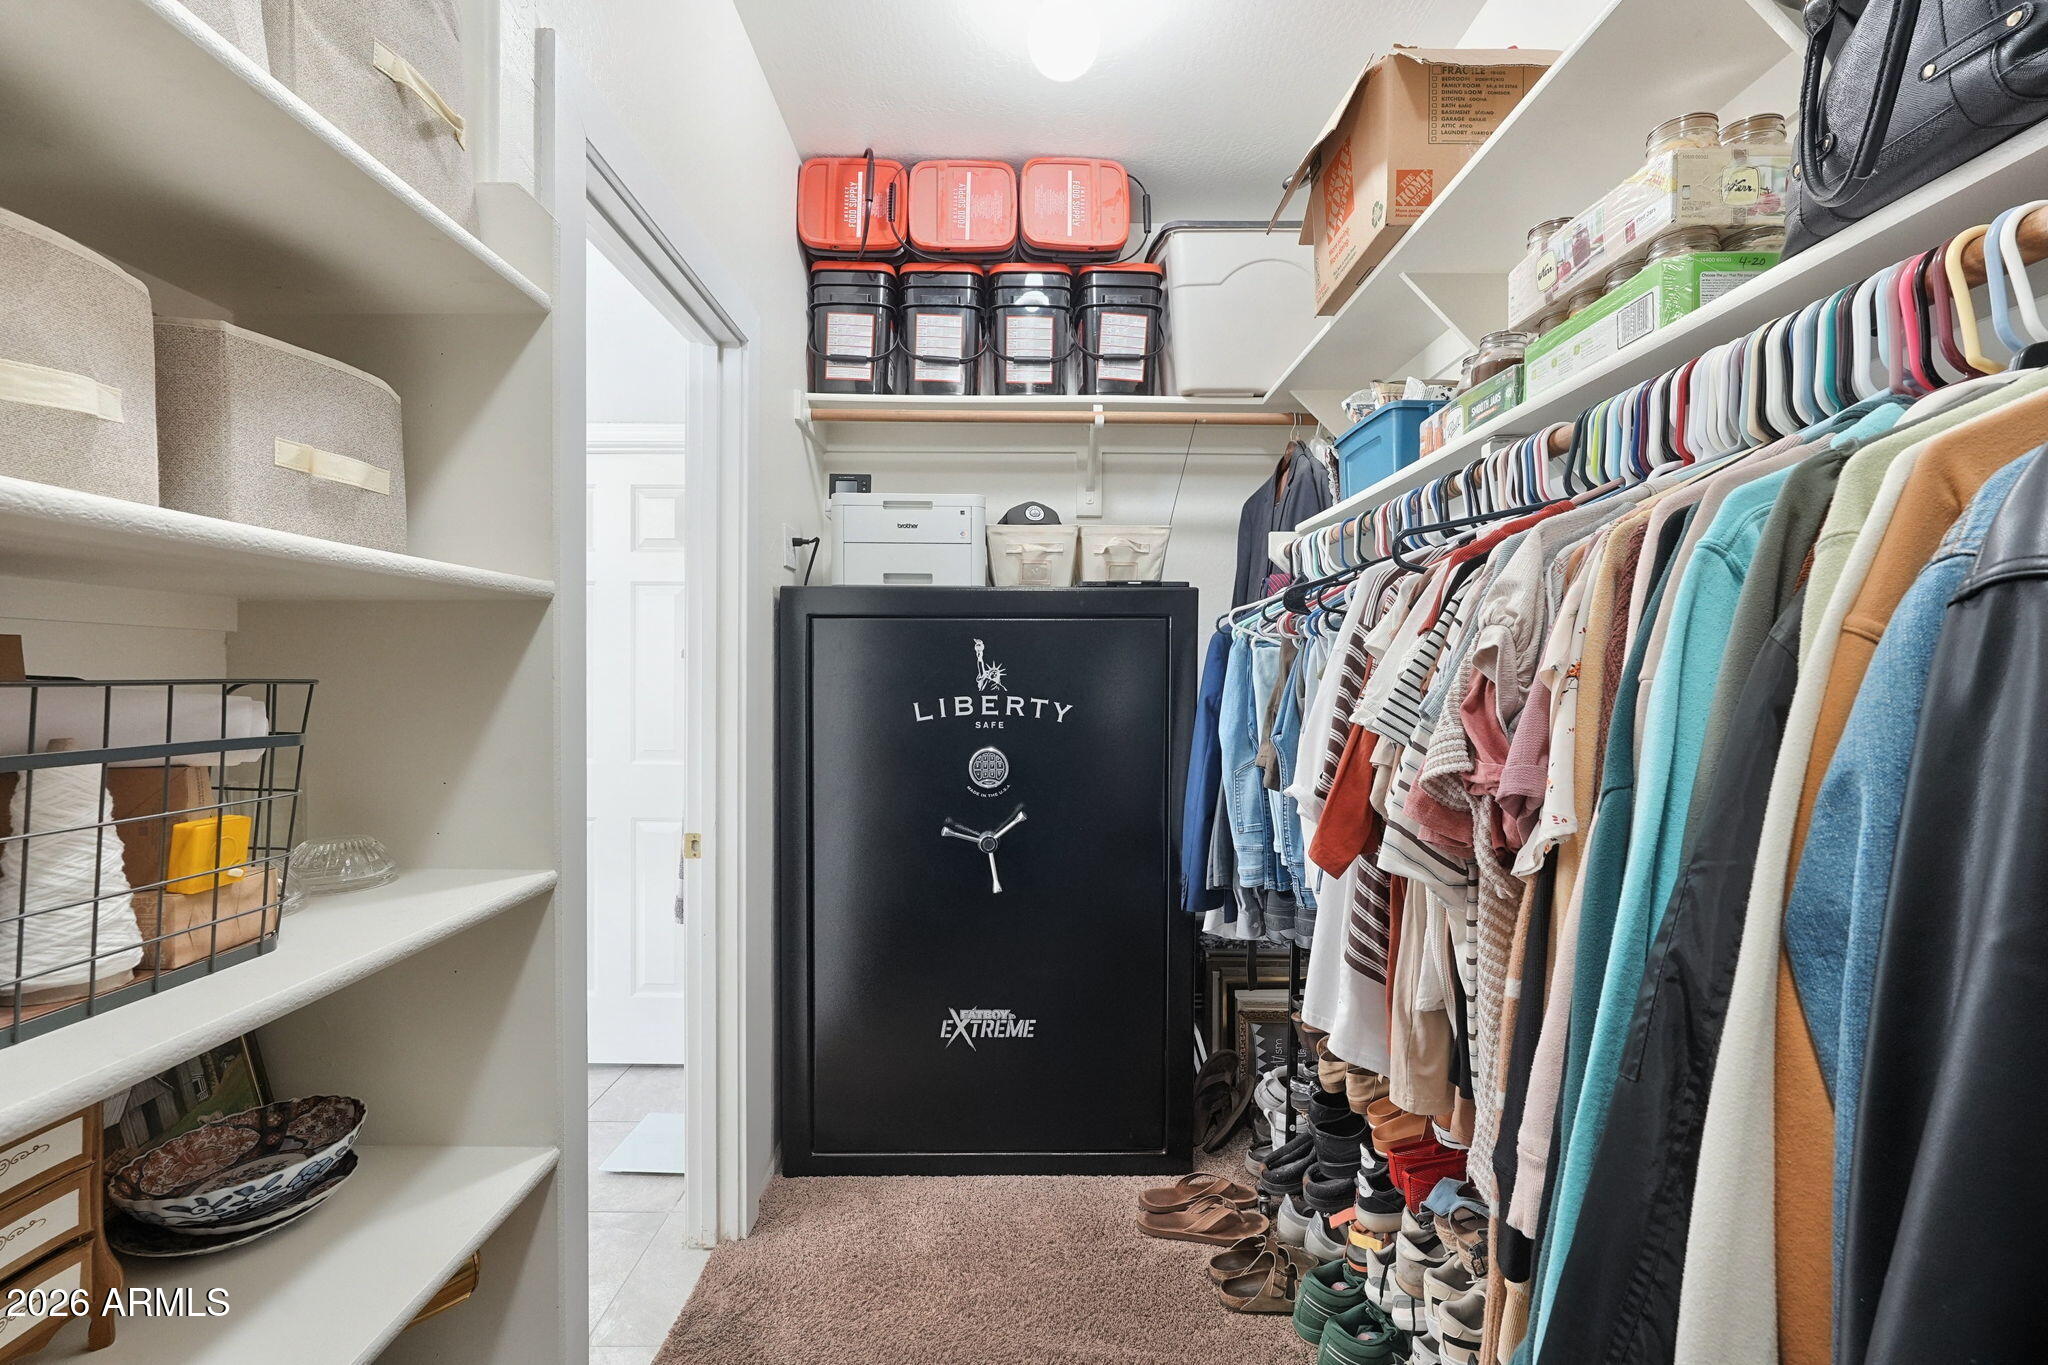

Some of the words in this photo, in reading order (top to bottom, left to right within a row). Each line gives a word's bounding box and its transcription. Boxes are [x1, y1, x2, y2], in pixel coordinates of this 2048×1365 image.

[1072, 180, 1081, 199] FOOD
[1395, 170, 1432, 206] HOME
[1400, 173, 1416, 188] THE
[849, 181, 859, 208] SUPPLY
[958, 182, 967, 209] SUPPLY
[848, 209, 857, 228] FOOD
[957, 210, 967, 229] FOOD
[1072, 200, 1081, 227] SUPPLY
[1739, 256, 1766, 269] 4-20
[913, 695, 1073, 722] LIBERTY
[975, 721, 1005, 729] SAFE
[966, 785, 980, 796] MADE
[960, 1009, 1010, 1020] FATBOY
[940, 1007, 1036, 1052] EXTREME
